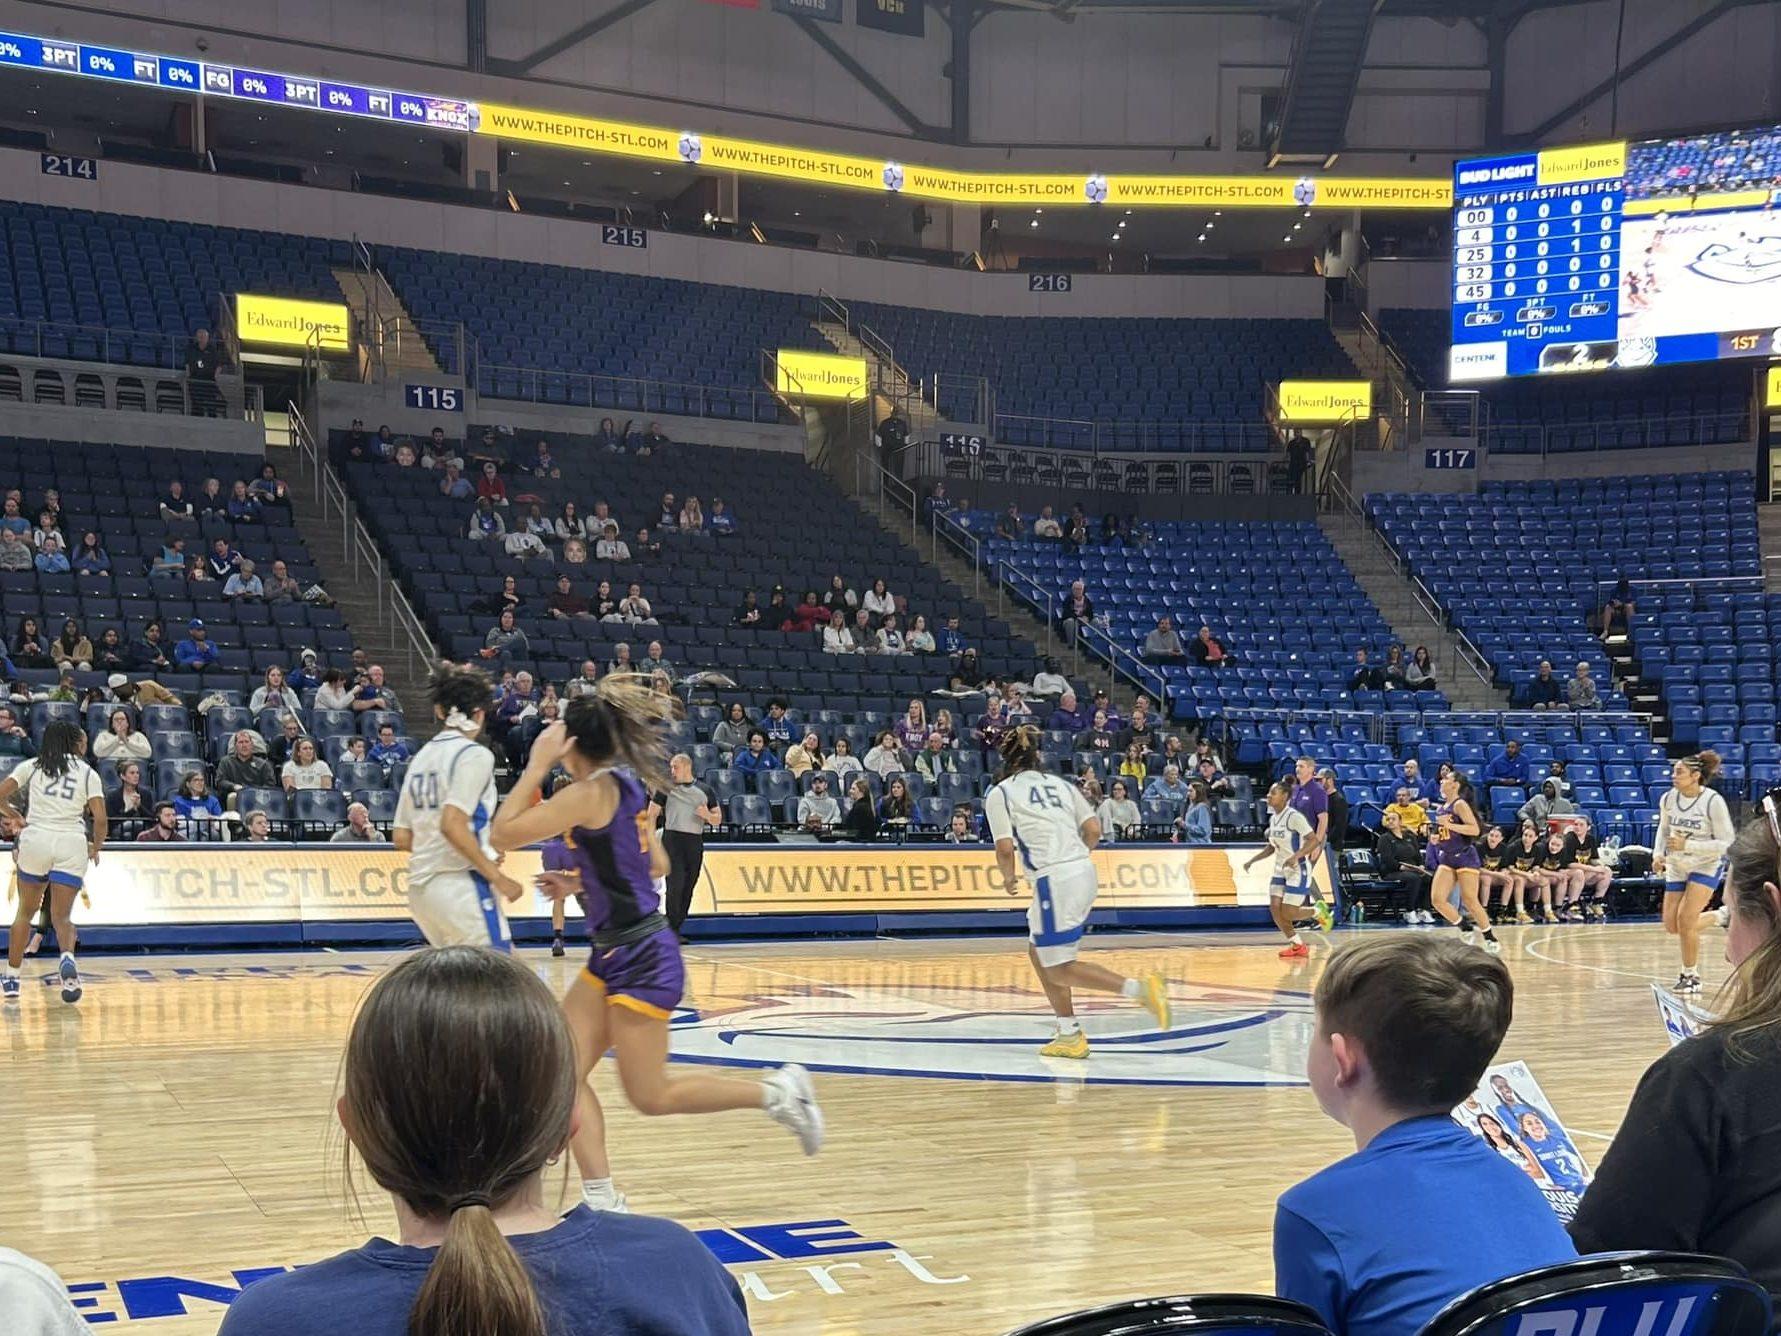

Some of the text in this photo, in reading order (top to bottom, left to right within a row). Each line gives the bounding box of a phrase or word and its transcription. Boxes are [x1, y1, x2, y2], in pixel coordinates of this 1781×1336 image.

[41, 46, 76, 65] 3PT
[89, 55, 115, 72] 0%
[133, 60, 155, 78] FT
[168, 67, 193, 83] 0%
[206, 70, 423, 117] FG 0% 3PT 0% FT 0%
[427, 108, 467, 126] KNOX
[492, 113, 668, 152] WWW.THEPITCH-STL.COM
[45, 156, 93, 178] 214
[712, 145, 874, 181] WWW.THEPITCH-STL.COM
[1460, 164, 1535, 185] BUD LIGHT
[913, 174, 1075, 196] WWW.THEPITCH-STL.COM
[1118, 183, 1284, 198] WWW.THEPITCH-STL.COM
[1463, 181, 1622, 207] PLY PTS AST REB FLS
[1467, 196, 1613, 224] 00 0 0 0 0
[606, 226, 644, 248] 215
[1471, 216, 1612, 242] 4 0 0 1 0
[1467, 235, 1612, 261] 25 0 0 1 0
[1467, 253, 1610, 280] 32 0 0 0 0
[1032, 274, 1068, 292] 216
[1466, 273, 1610, 298] 45 0 0 0 0
[1582, 293, 1595, 301] FT
[1502, 328, 1526, 337] TEAM
[1543, 325, 1571, 333] FOULS
[1731, 335, 1760, 350] 1ST
[414, 387, 456, 410] 115
[945, 434, 980, 456] 116
[1432, 450, 1469, 468] 117
[44, 774, 78, 800] 25
[1030, 786, 1063, 809] 45
